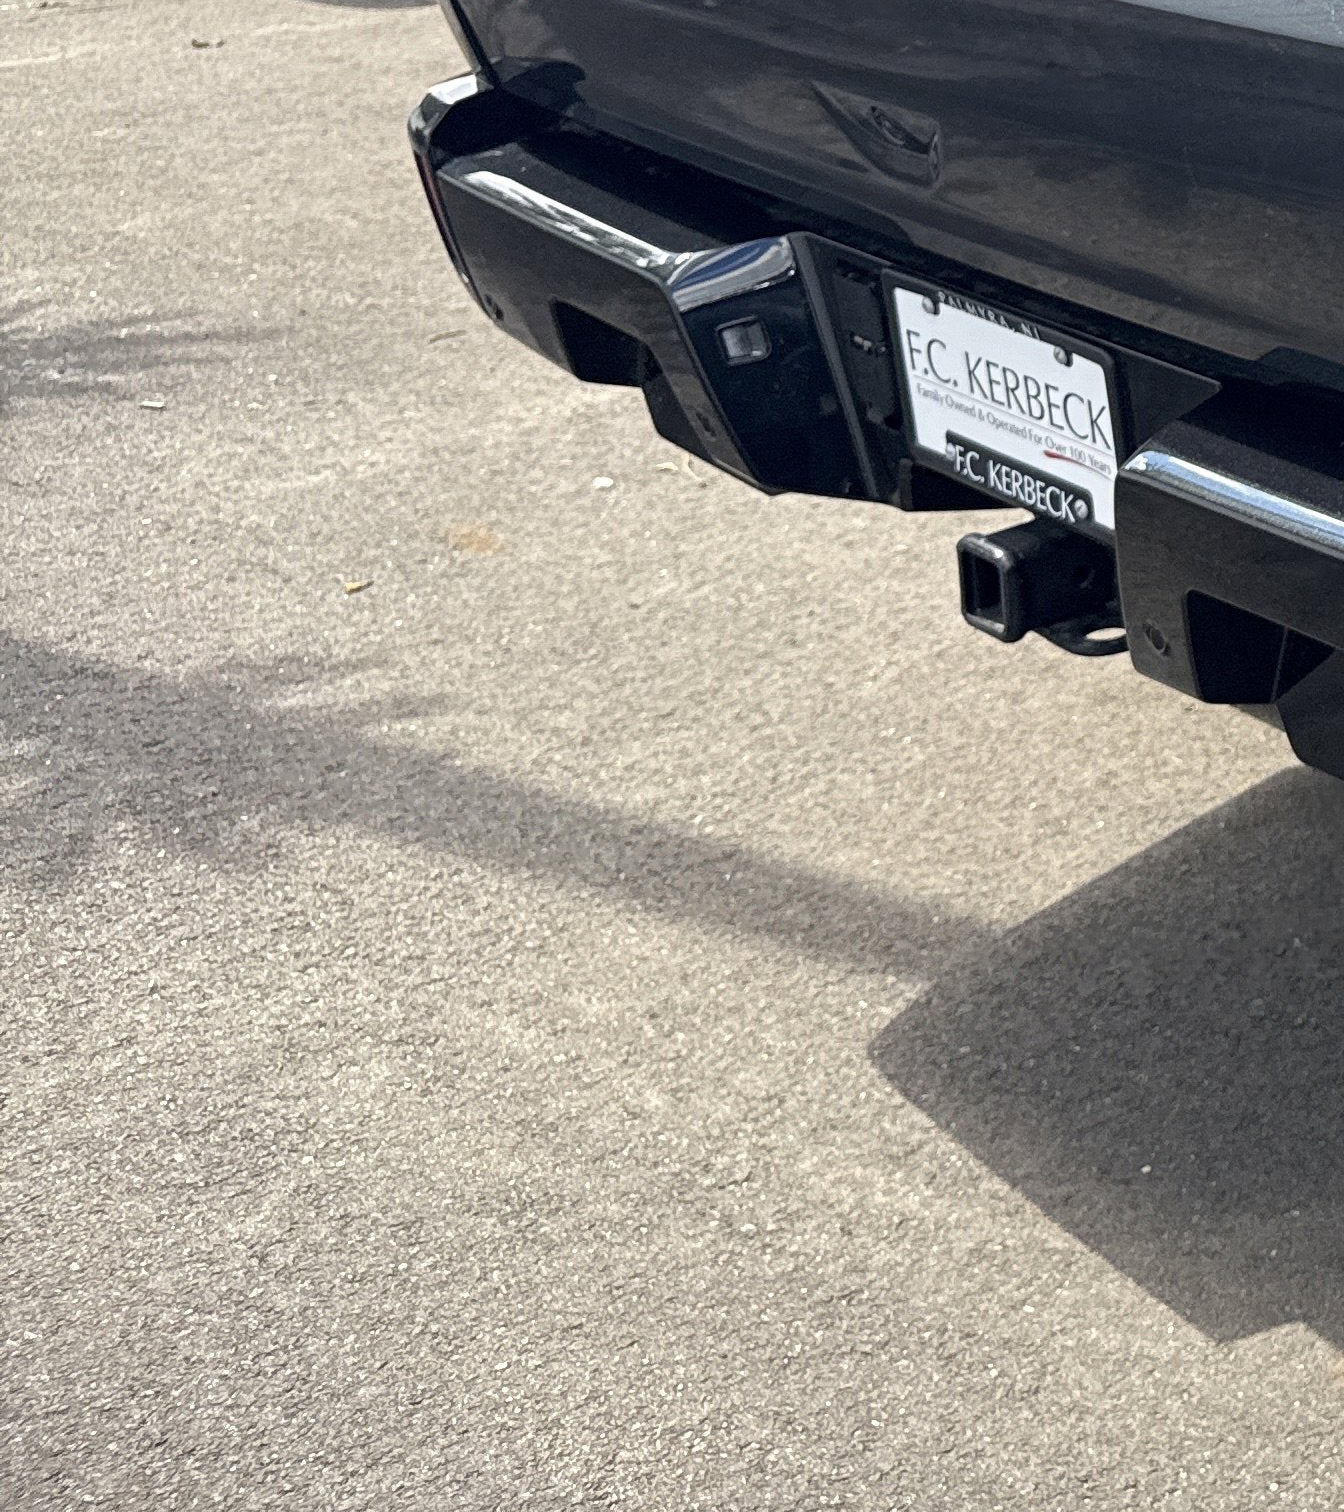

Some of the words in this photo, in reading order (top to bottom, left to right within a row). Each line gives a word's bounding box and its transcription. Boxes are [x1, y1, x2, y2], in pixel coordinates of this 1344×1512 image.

[905, 329, 958, 387] F.C.
[964, 350, 1112, 450] KERBECK
[916, 382, 945, 407] Family
[945, 393, 976, 418] Owned
[986, 411, 1028, 440] Operated
[1028, 428, 1043, 444] For
[1044, 435, 1068, 456] Over
[1069, 445, 1087, 464] 100
[1086, 453, 1112, 475] Years
[953, 445, 985, 483] F.C.
[988, 457, 1076, 524] KERBECK
